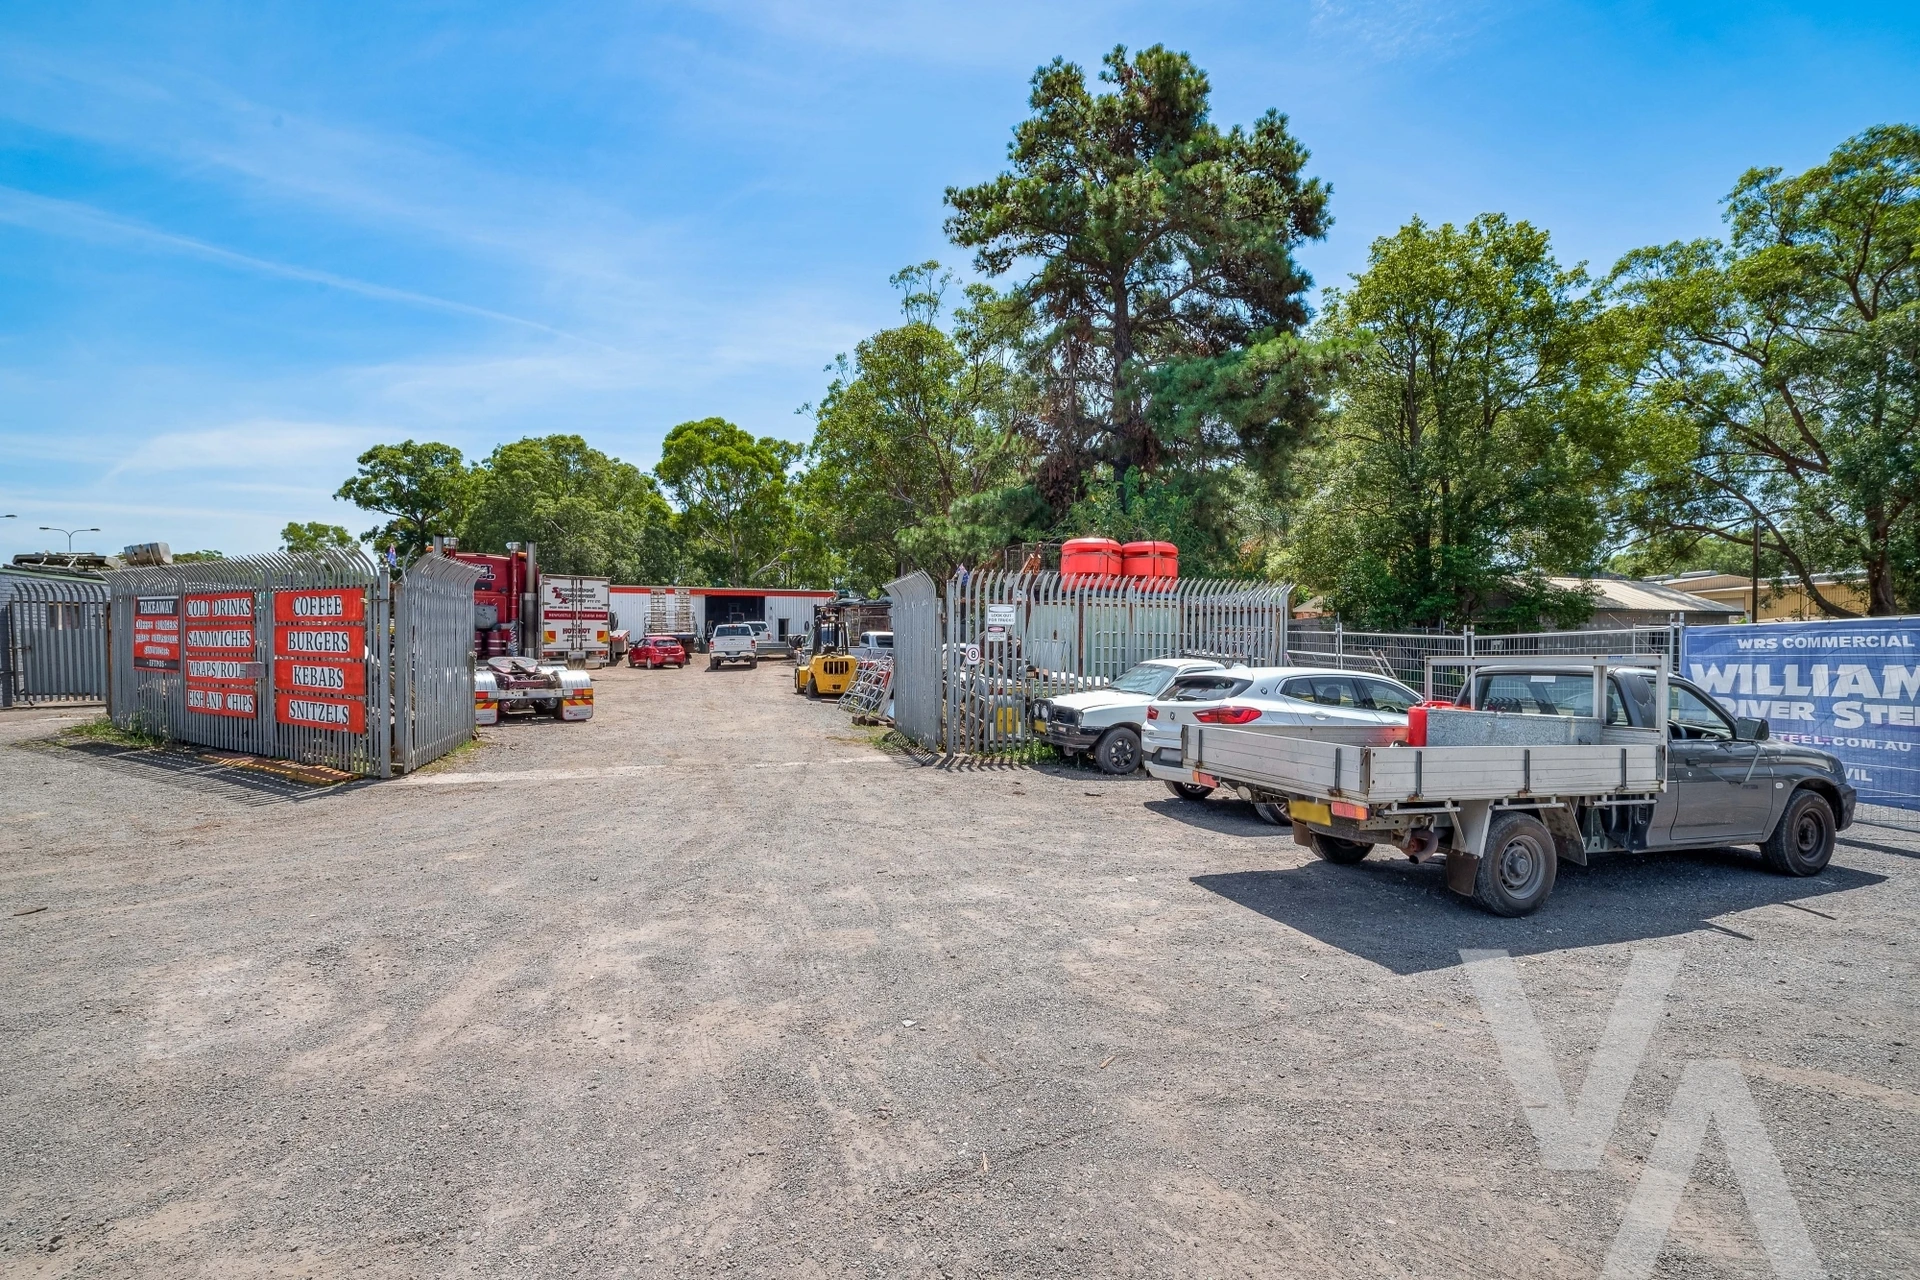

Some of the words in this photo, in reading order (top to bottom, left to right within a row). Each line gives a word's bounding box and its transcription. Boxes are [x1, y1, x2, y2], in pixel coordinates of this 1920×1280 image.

[139, 601, 174, 614] TAKEAWAY
[186, 599, 210, 617] COLD
[212, 598, 251, 617] DRINKS
[293, 596, 342, 616] COFFEE
[187, 630, 251, 647] SANDWICHES
[288, 631, 349, 652] BURGERS
[1737, 638, 1778, 649] WRS
[1783, 635, 1915, 649] COMMERCIAL
[188, 661, 240, 678] WRAPS/ROL
[293, 665, 343, 688] KEBABS
[188, 690, 205, 707] FISH
[206, 691, 223, 710] AND
[226, 693, 254, 713] CHIPS
[289, 700, 349, 725] SNITZELS
